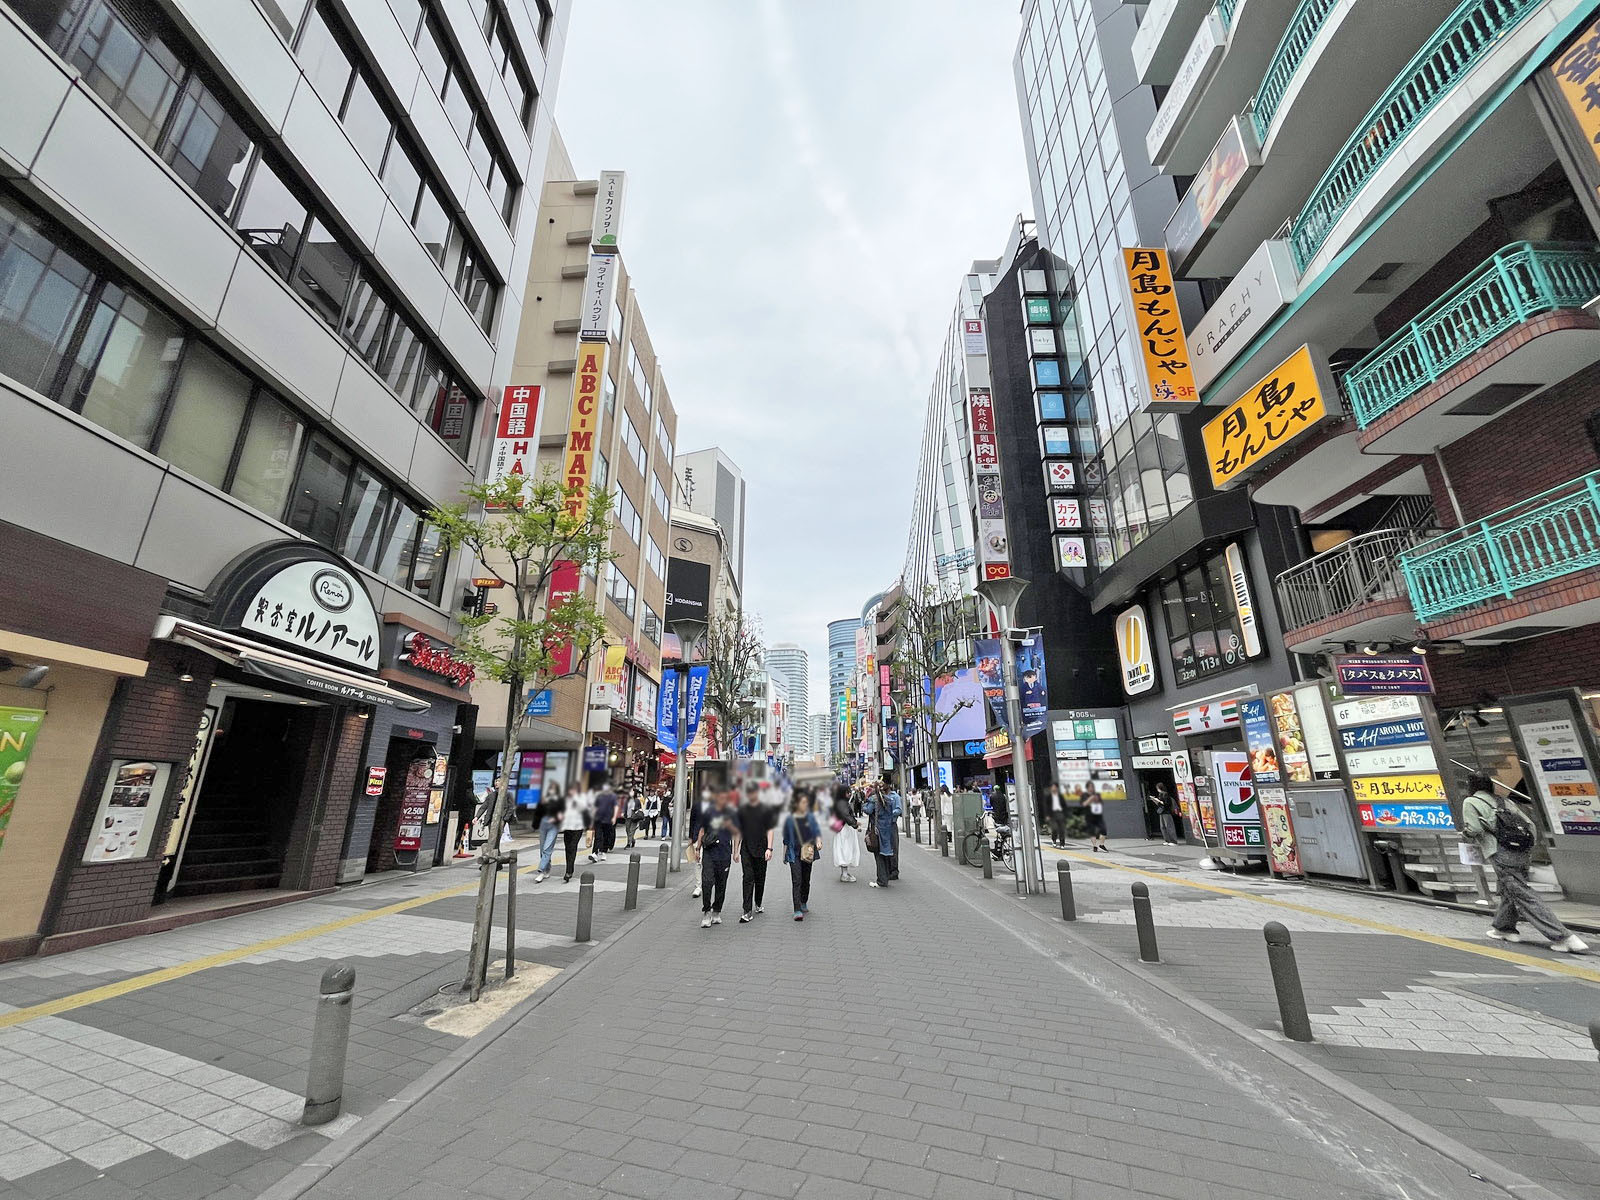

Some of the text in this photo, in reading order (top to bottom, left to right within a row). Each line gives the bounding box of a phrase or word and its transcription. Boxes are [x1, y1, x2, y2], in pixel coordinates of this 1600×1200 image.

[604, 178, 616, 233] スーモカウンター
[1131, 251, 1188, 375] 月島もんじゃ
[1178, 385, 1195, 397] 3F
[507, 387, 531, 435] 中国語
[1221, 377, 1296, 448] 月島
[1215, 397, 1316, 475] もんじゃ
[1339, 709, 1350, 720] 6F
[1343, 731, 1356, 747] 5F
[1379, 724, 1406, 736] AROMA
[1349, 758, 1361, 769] 4F
[1323, 771, 1332, 779] 4F
[1369, 781, 1433, 795] 月島もんじゃ
[1361, 810, 1374, 821] B1
[1225, 829, 1244, 842] たばこ
[1247, 829, 1260, 843] 酒
